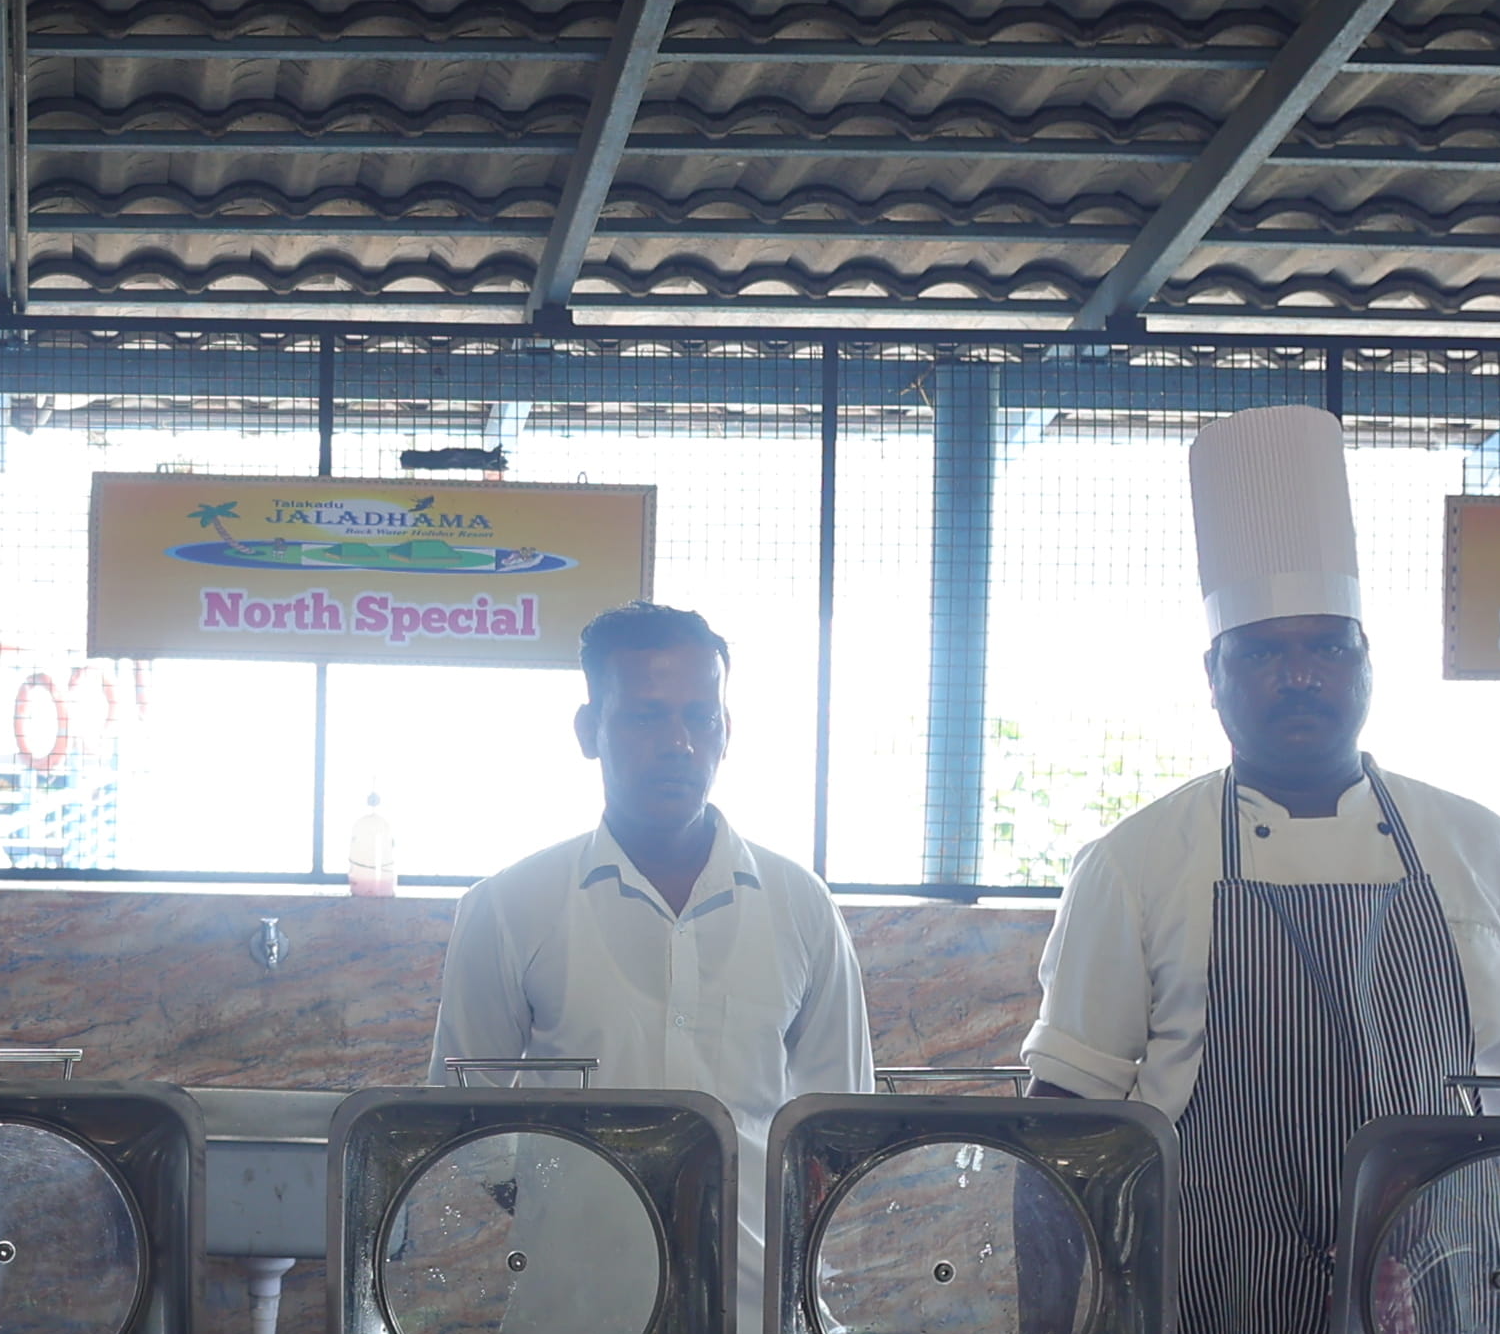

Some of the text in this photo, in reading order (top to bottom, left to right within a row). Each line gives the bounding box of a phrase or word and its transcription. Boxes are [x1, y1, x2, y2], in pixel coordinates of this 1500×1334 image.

[272, 498, 345, 510] Talakadu
[264, 509, 494, 530] JALADHAMA
[202, 591, 537, 643] North Special
